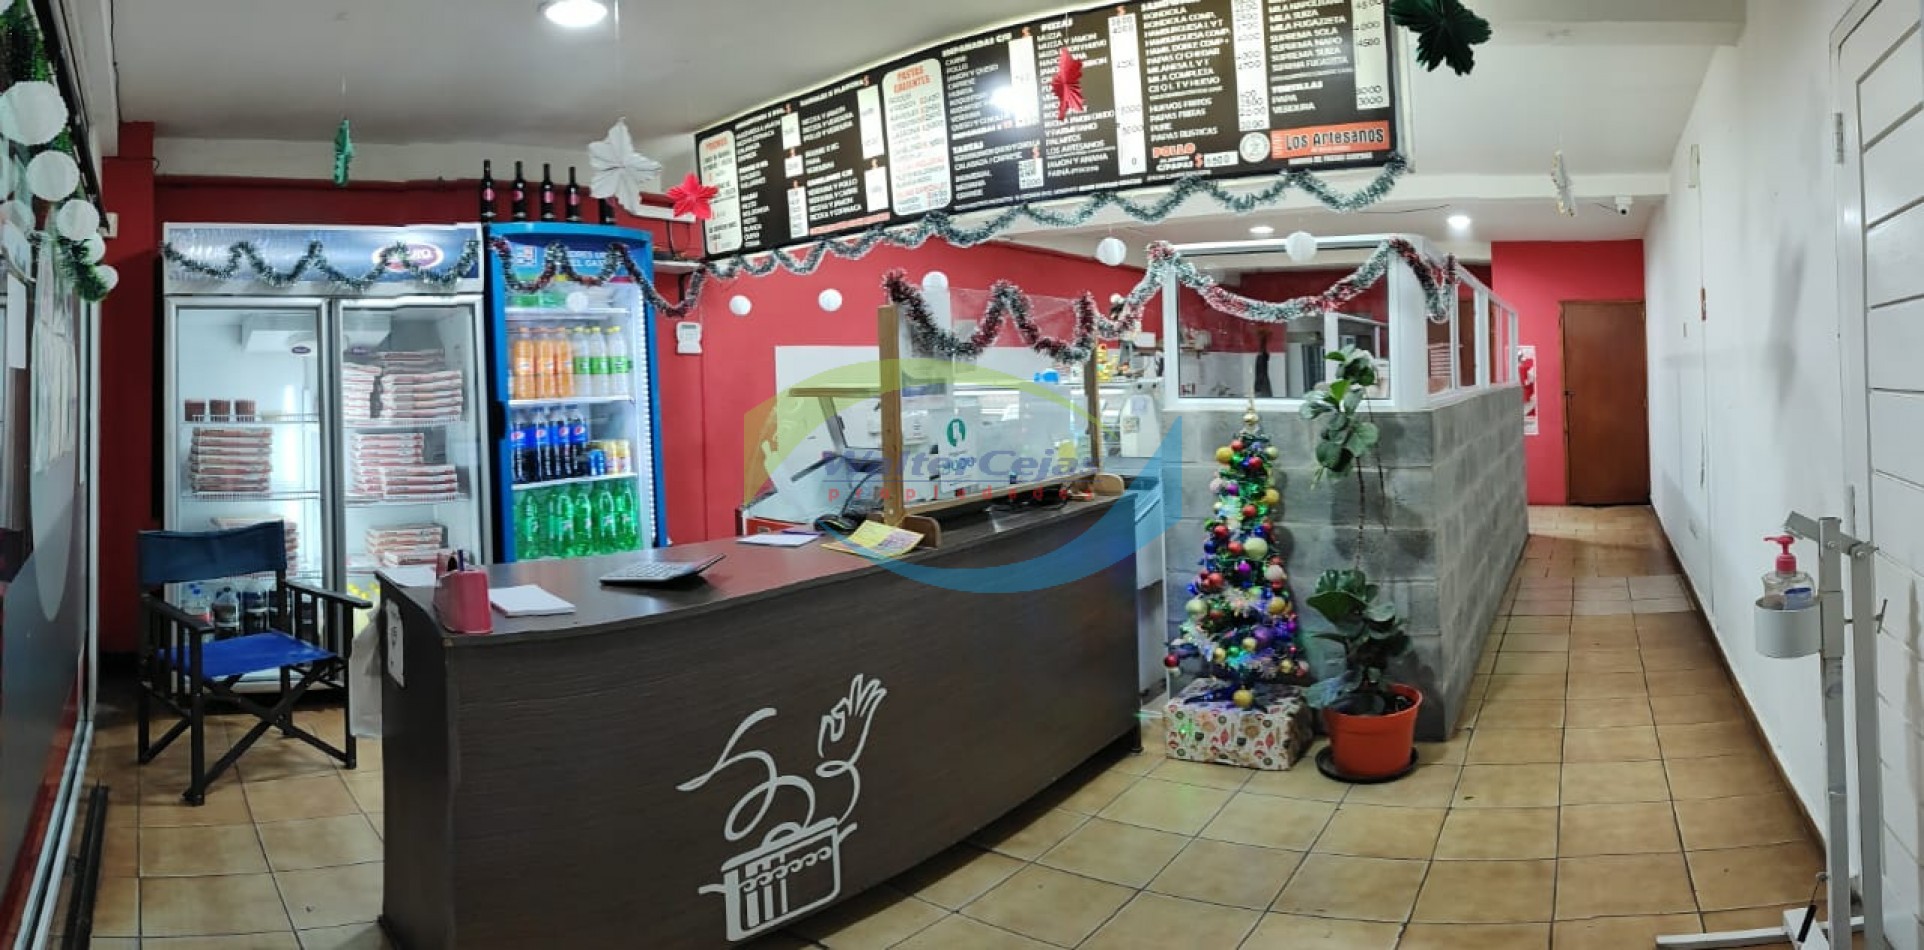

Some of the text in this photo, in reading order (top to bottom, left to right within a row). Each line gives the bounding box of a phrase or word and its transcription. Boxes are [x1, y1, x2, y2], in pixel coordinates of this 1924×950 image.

[1286, 135, 1309, 152] Los
[1313, 127, 1385, 147] Artesanos
[1153, 143, 1196, 159] POLLO
